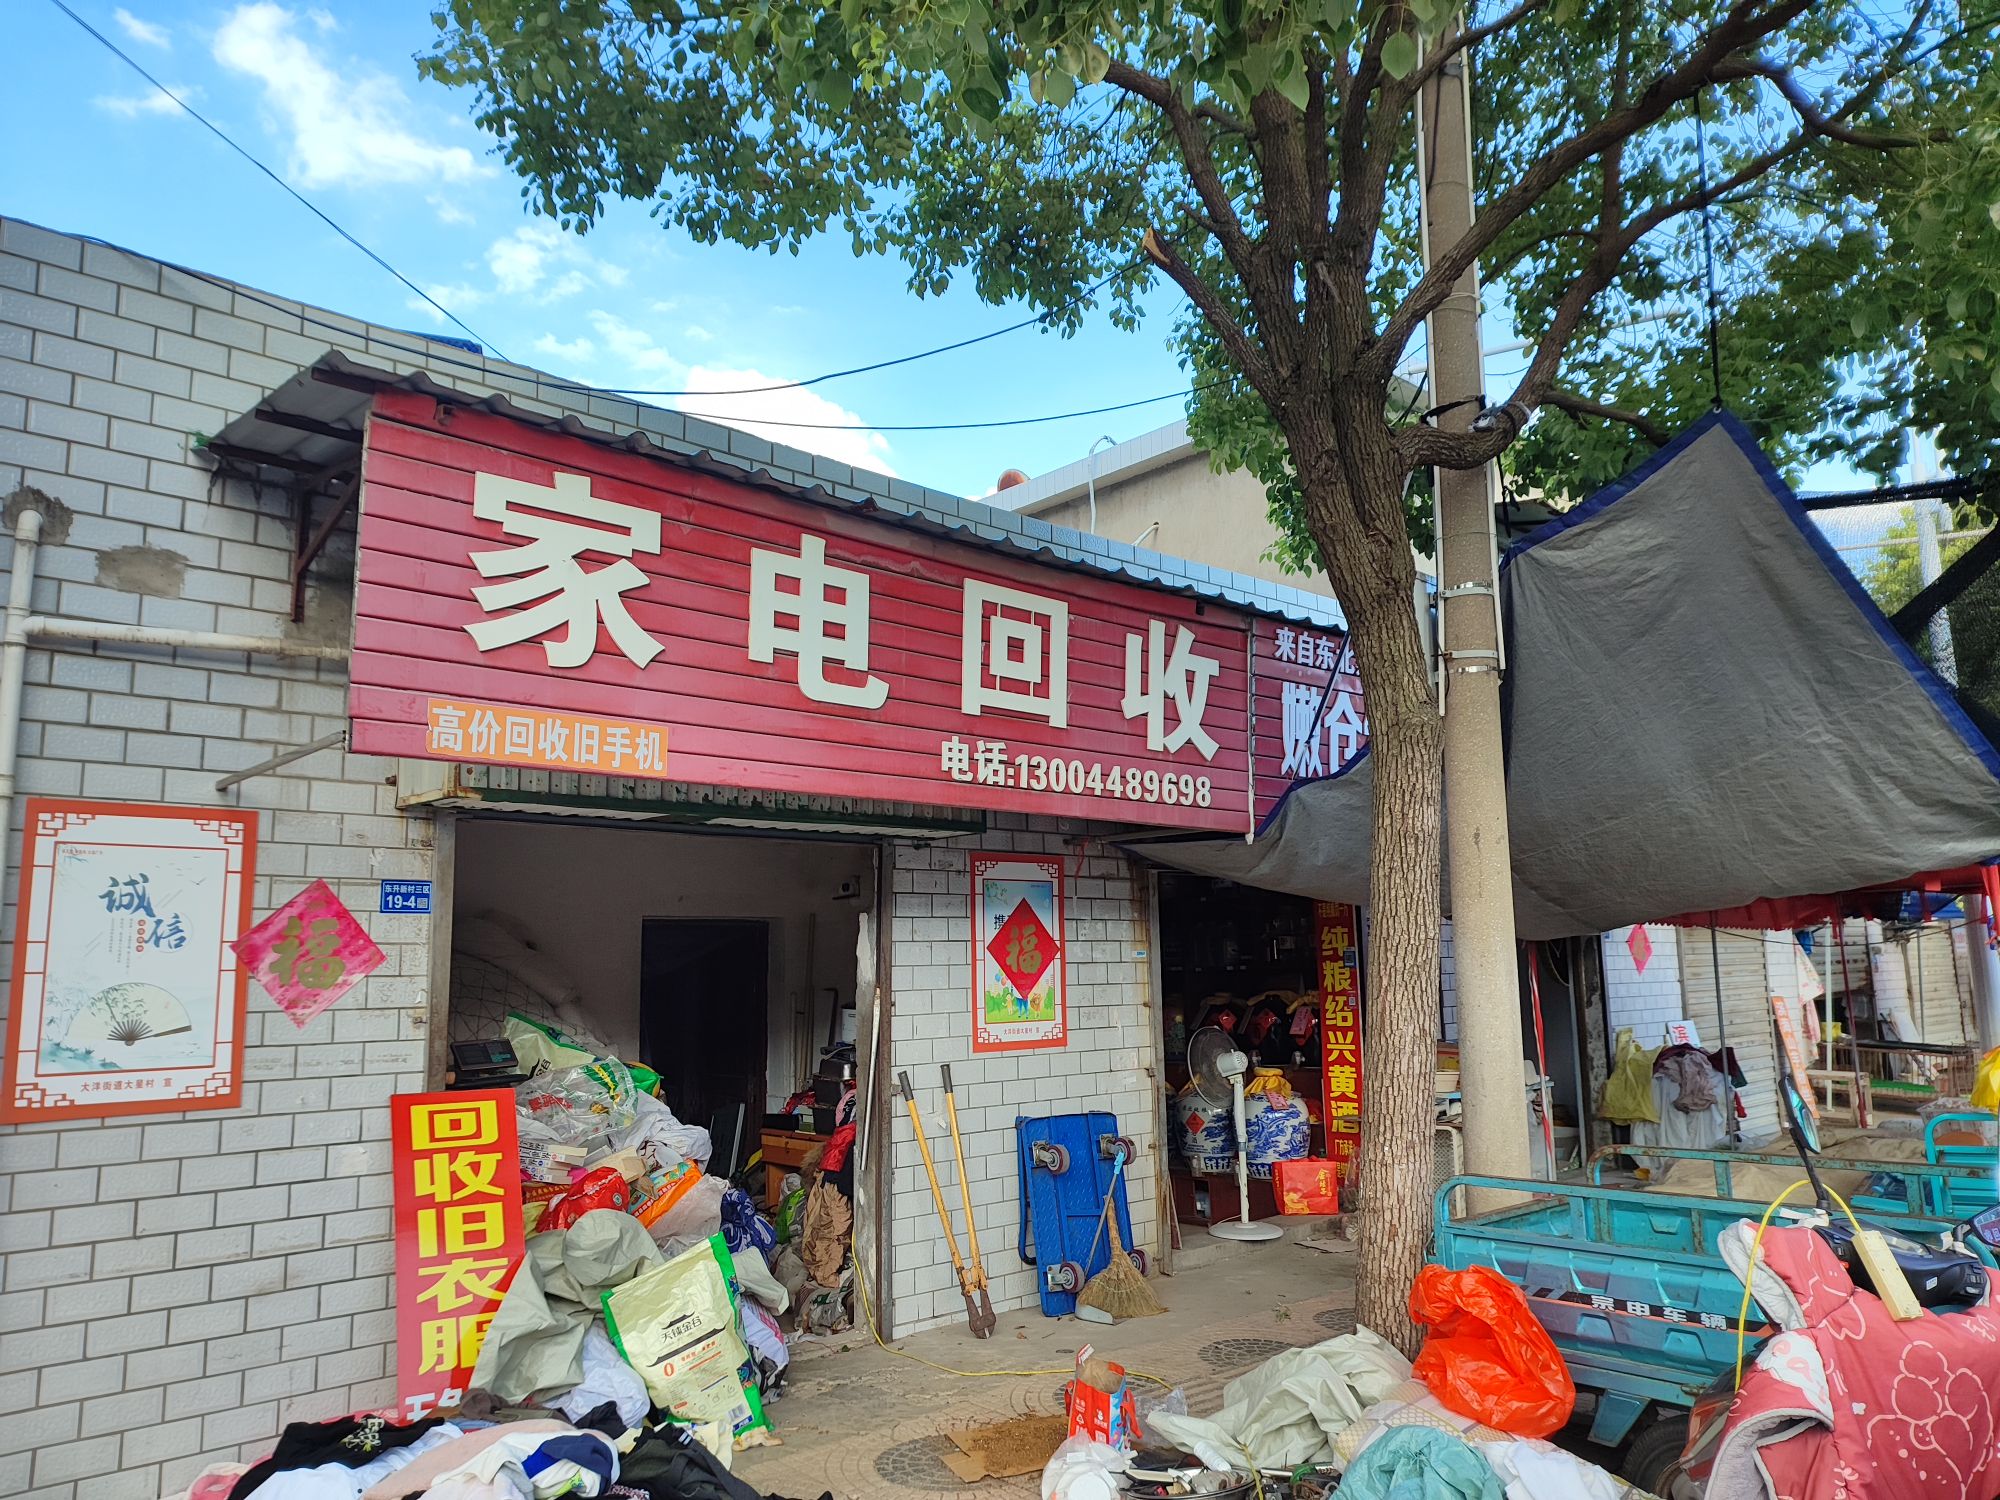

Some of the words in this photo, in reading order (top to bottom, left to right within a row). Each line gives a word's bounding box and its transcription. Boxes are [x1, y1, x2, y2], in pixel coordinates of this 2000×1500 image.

[461, 471, 1220, 762] 家电回收
[1274, 626, 1362, 677] 来自东北
[428, 704, 664, 771] 高价回收旧手机
[385, 884, 430, 894] 东升新村三区
[386, 894, 416, 909] 19-4
[269, 915, 346, 990] 福
[1005, 924, 1043, 975] 福
[1320, 926, 1360, 1134] 纯粮绍兴黄酒
[1590, 1294, 1727, 1331] 宗申车辆
